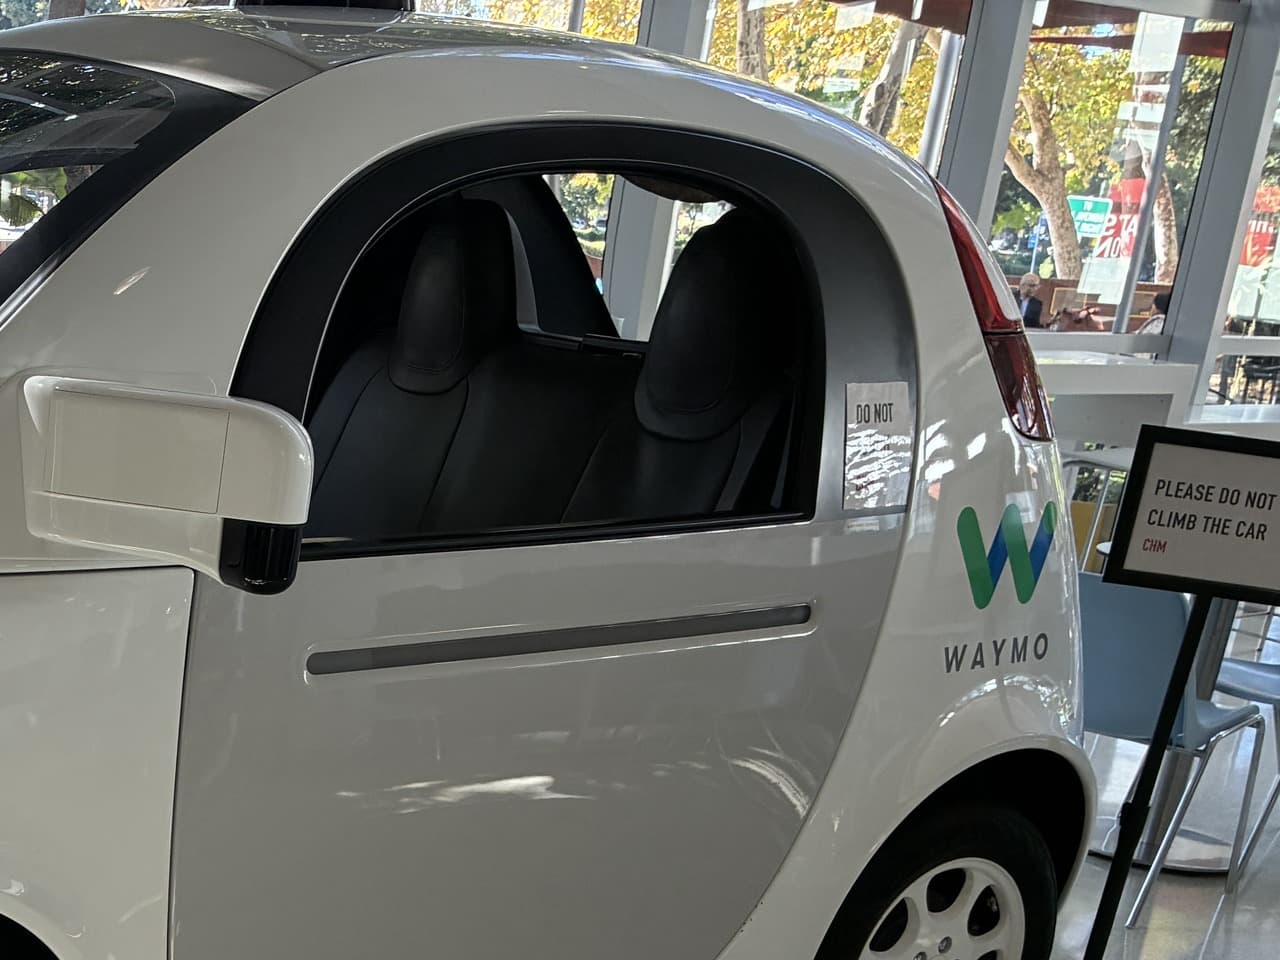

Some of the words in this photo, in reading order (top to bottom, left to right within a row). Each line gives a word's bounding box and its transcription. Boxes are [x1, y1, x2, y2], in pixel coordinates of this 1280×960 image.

[856, 404, 871, 423] DO
[874, 403, 894, 423] NOT
[1155, 479, 1215, 503] PLEASE
[1218, 487, 1240, 506] DO
[1245, 490, 1277, 511] NOT
[1147, 508, 1197, 531] CLIMB
[1202, 515, 1232, 536] THE
[1235, 520, 1267, 541] CAR
[1142, 538, 1167, 553] CHM
[944, 632, 1048, 673] WAYMO
